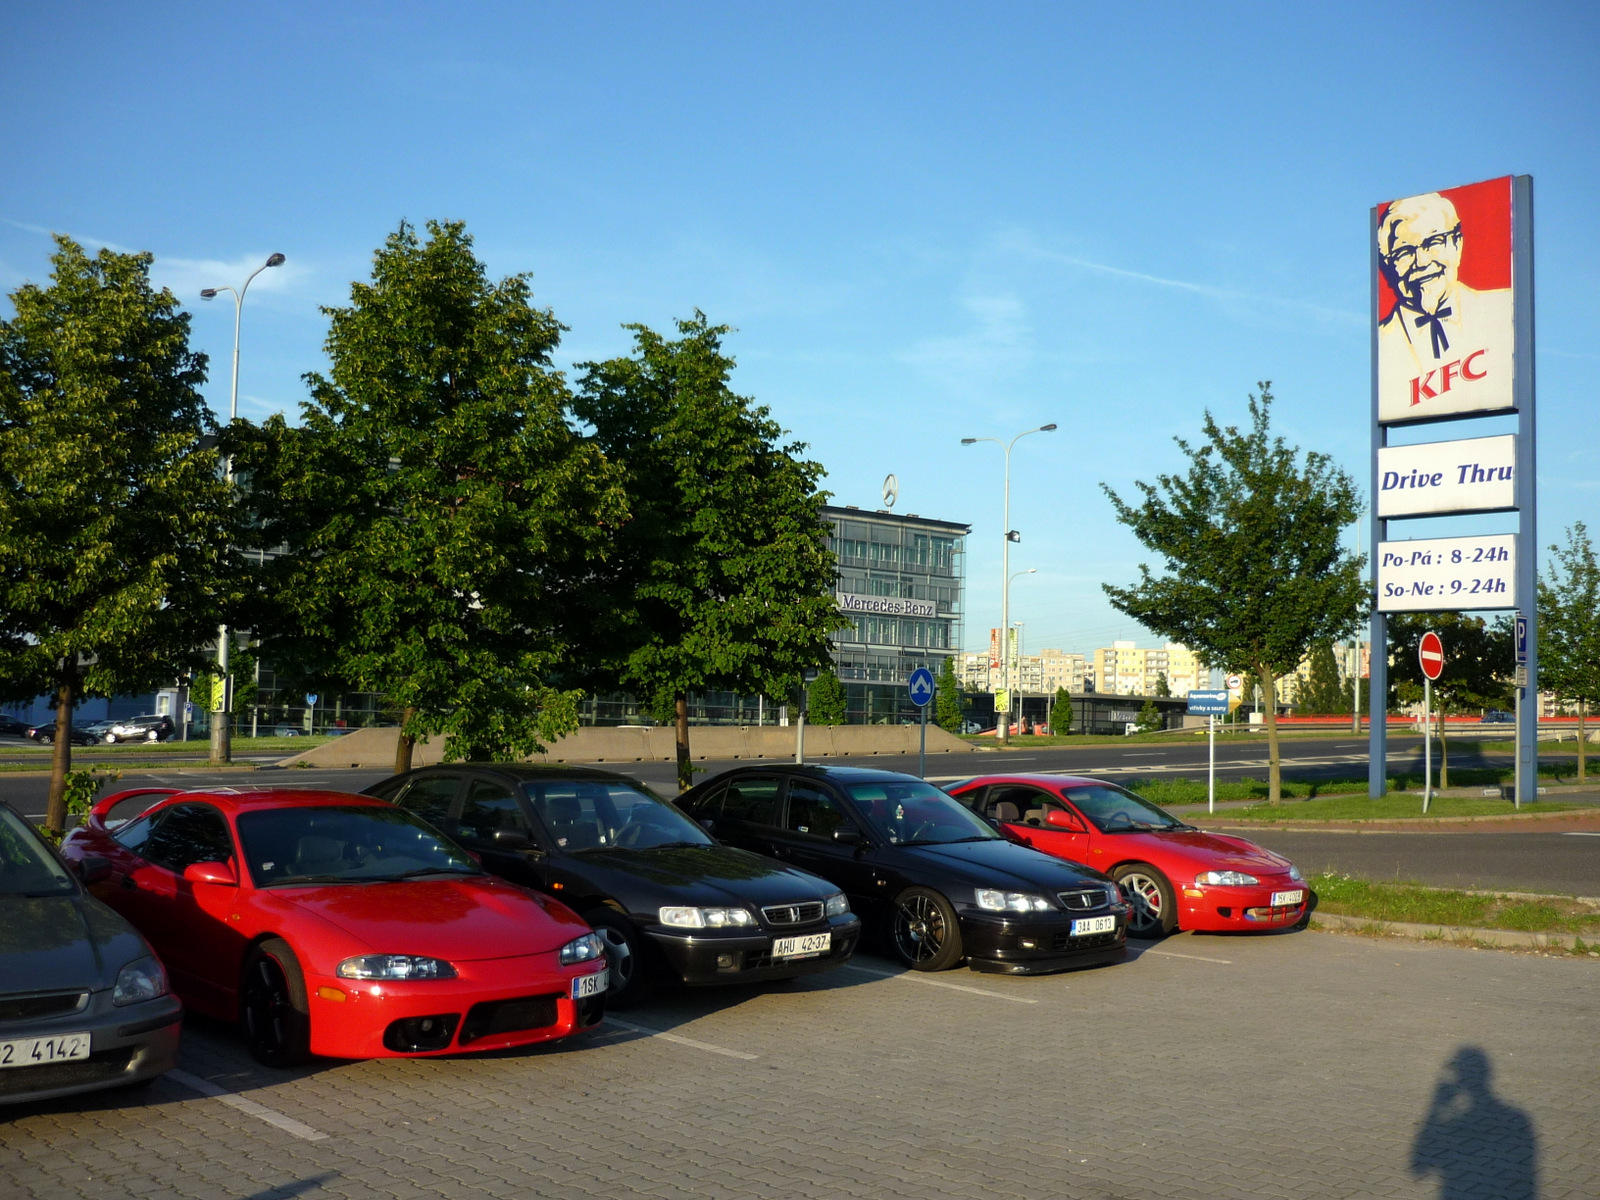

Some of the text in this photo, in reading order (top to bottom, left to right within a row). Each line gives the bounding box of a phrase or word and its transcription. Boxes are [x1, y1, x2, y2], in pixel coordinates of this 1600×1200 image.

[1409, 349, 1488, 408] KFC
[1381, 463, 1513, 491] Drive Thru
[1450, 578, 1506, 595] 9-24h
[842, 594, 933, 616] Mercedes-Benz
[1077, 917, 1112, 933] 3AA 0613
[777, 940, 795, 955] AHU
[582, 976, 599, 994] 1SK
[31, 1039, 81, 1061] 4142
